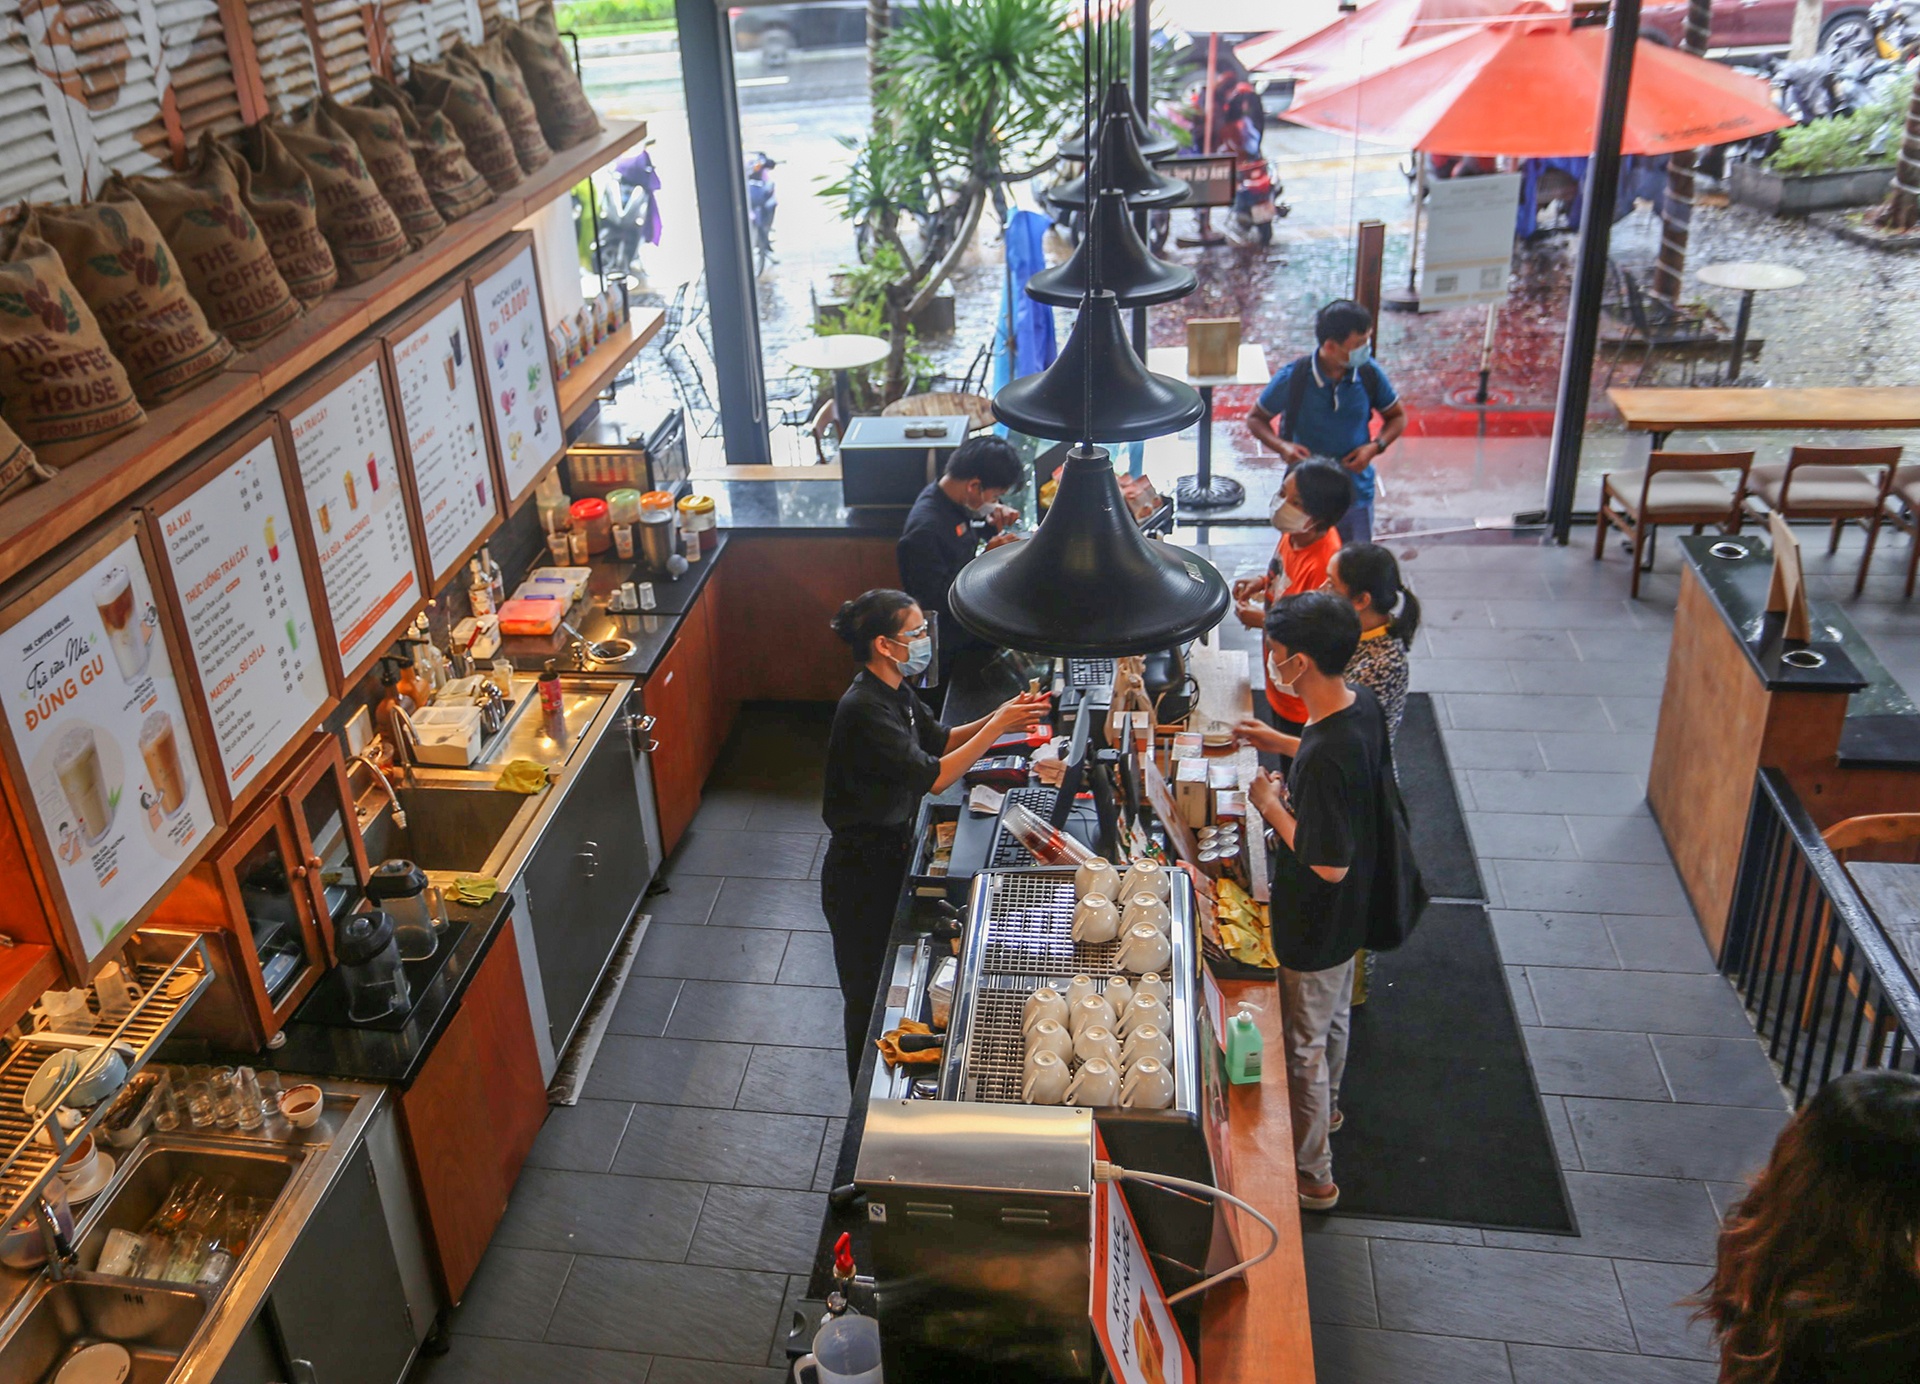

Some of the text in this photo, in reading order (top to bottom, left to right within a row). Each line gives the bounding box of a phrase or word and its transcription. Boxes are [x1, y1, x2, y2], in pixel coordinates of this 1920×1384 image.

[191, 242, 239, 275] THE
[270, 227, 325, 260] COFF
[279, 249, 333, 278] HOUS
[99, 290, 149, 322] THE
[218, 280, 282, 322] HOUSE
[120, 297, 193, 344] COFFEE
[3, 334, 60, 366] THE
[16, 347, 113, 384] COFFEE
[131, 325, 204, 372] HOUSE
[29, 376, 119, 414] HOUSE
[177, 509, 192, 528] XAY
[22, 615, 70, 655] THE COFFEE HOUSE
[25, 654, 104, 731] ĐÚNG GU
[210, 671, 235, 700] MATCHA
